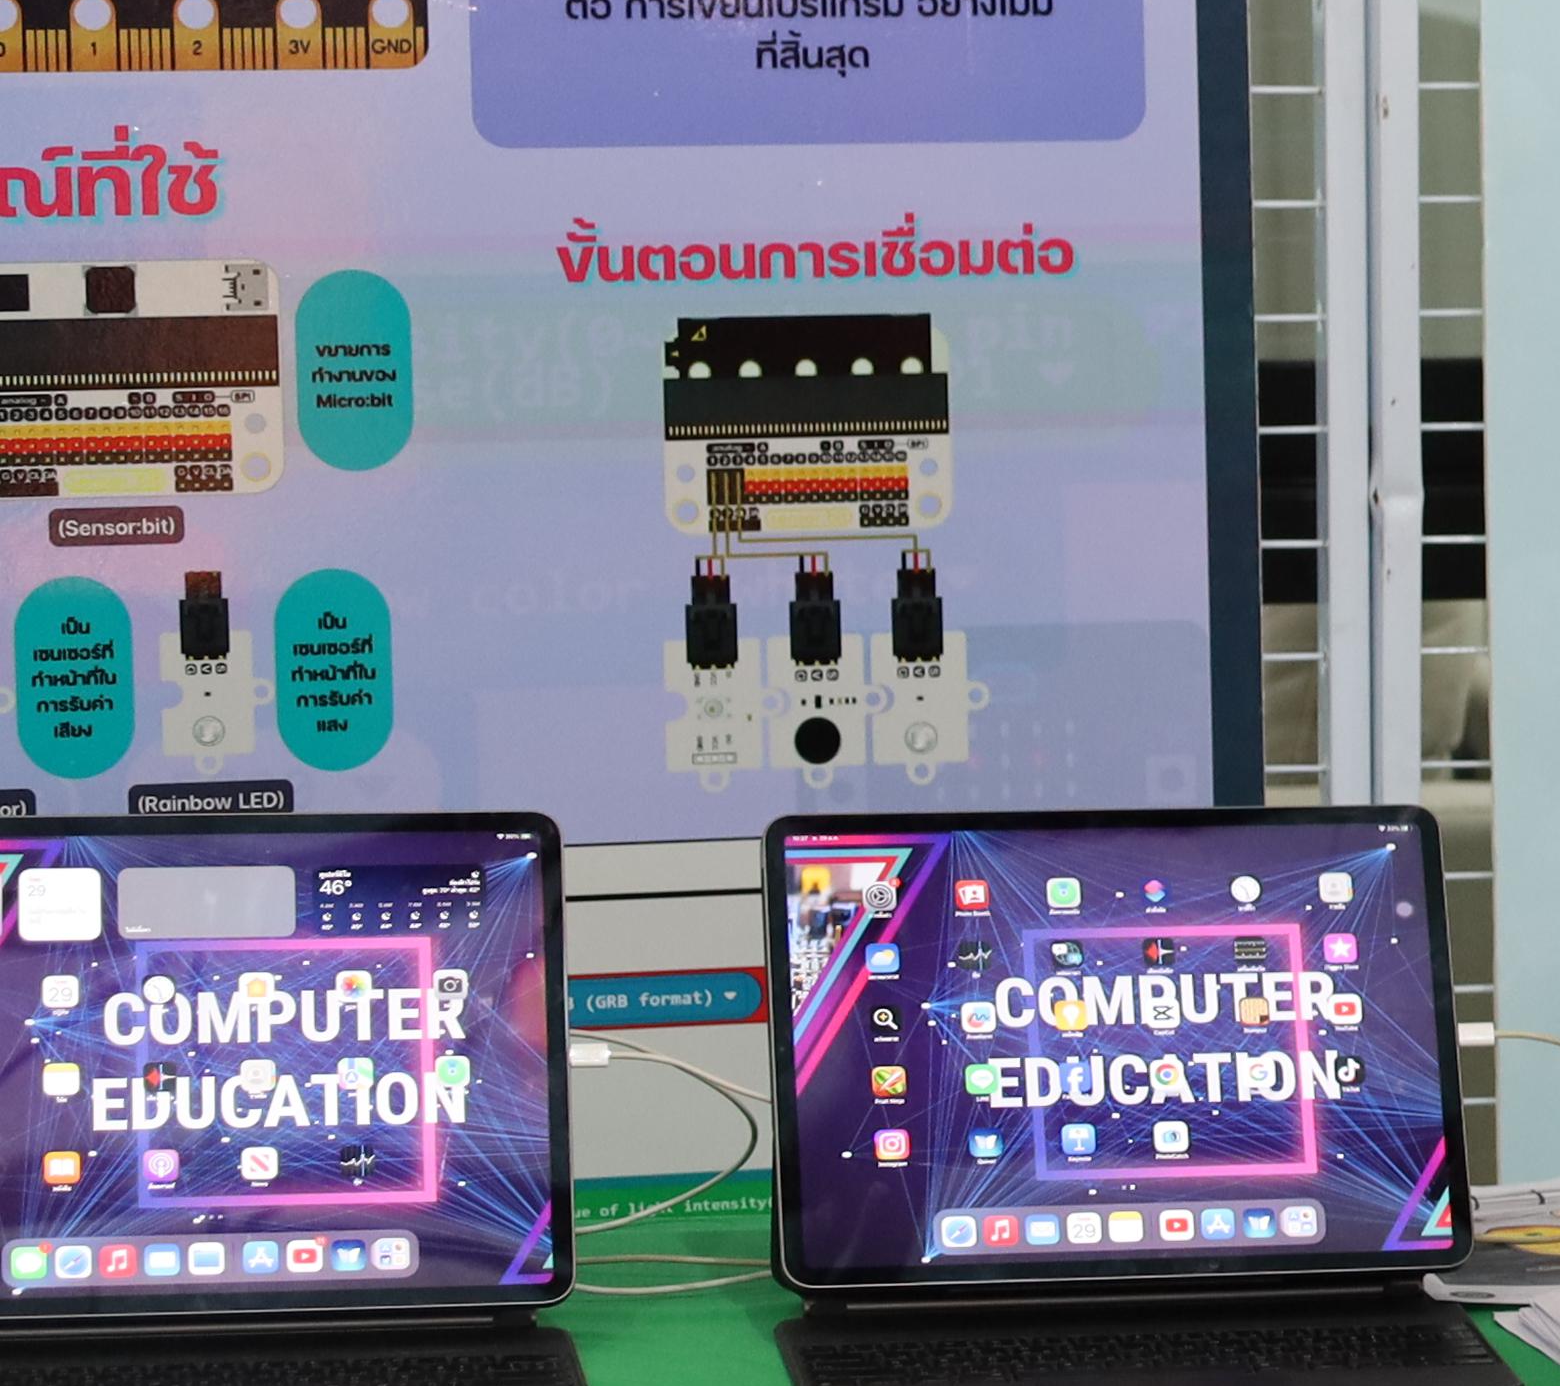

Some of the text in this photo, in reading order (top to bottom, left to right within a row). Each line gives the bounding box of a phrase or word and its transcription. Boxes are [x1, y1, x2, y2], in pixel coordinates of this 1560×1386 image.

[192, 40, 203, 56] 2
[288, 39, 312, 55] 3V
[371, 38, 412, 55] GND
[755, 30, 870, 79] ที่สิ้นสุด
[557, 213, 1074, 283] ขั้นตอนการเชื่อมต่อ
[316, 392, 393, 409] Micro:bit
[58, 515, 175, 539] (Sensor:bit)
[137, 790, 285, 815] (Rainbow LED)
[48, 984, 73, 1002] 29
[586, 987, 713, 1013] (GRB format)
[995, 972, 1335, 1028] COMPUTER
[103, 987, 466, 1046] COMPUTER
[988, 1050, 1341, 1109] EDUCATION
[92, 1072, 466, 1132] EDUCATION
[599, 1203, 620, 1216] of
[1073, 1222, 1096, 1238] 29
